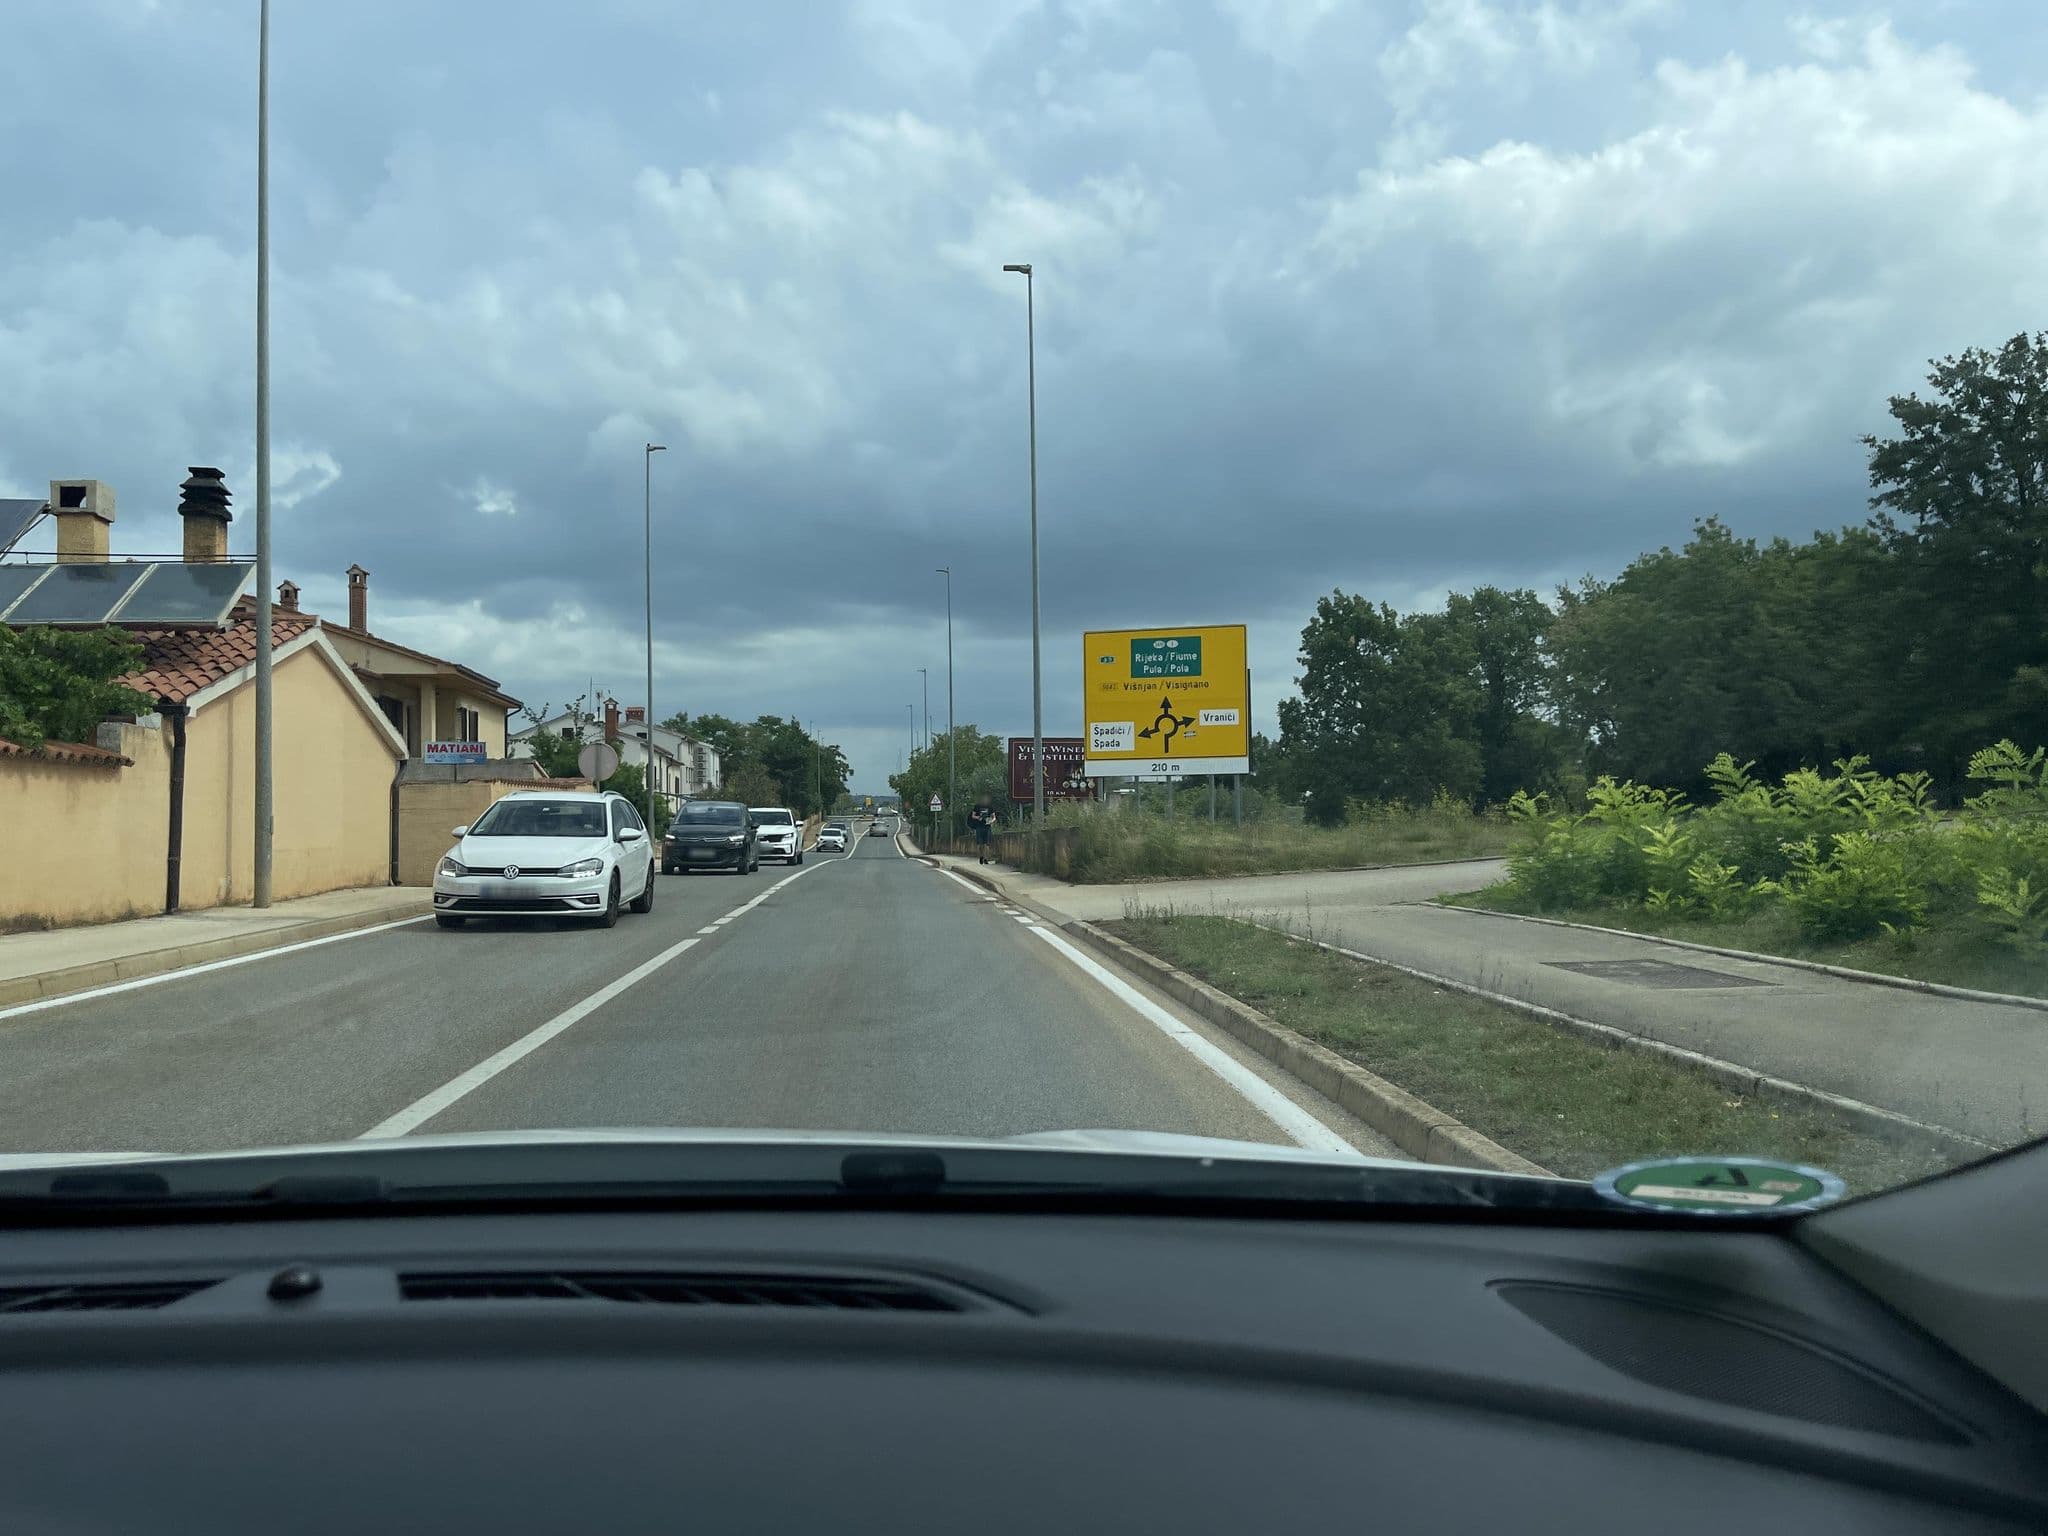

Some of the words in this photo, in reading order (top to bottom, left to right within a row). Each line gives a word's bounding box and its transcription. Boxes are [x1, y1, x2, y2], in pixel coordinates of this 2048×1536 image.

[1135, 653, 1163, 664] Rijeka
[1170, 652, 1198, 661] Fiume
[1143, 665, 1162, 673] Pula
[1170, 664, 1189, 673] Pola
[1123, 682, 1157, 692] Višnjan
[1166, 680, 1209, 691] Visignano
[427, 744, 483, 753] MATIANI
[1094, 739, 1120, 749] Spada
[1018, 745, 1047, 753] VIST
[1050, 745, 1084, 753] WINE
[1151, 764, 1168, 772] 210
